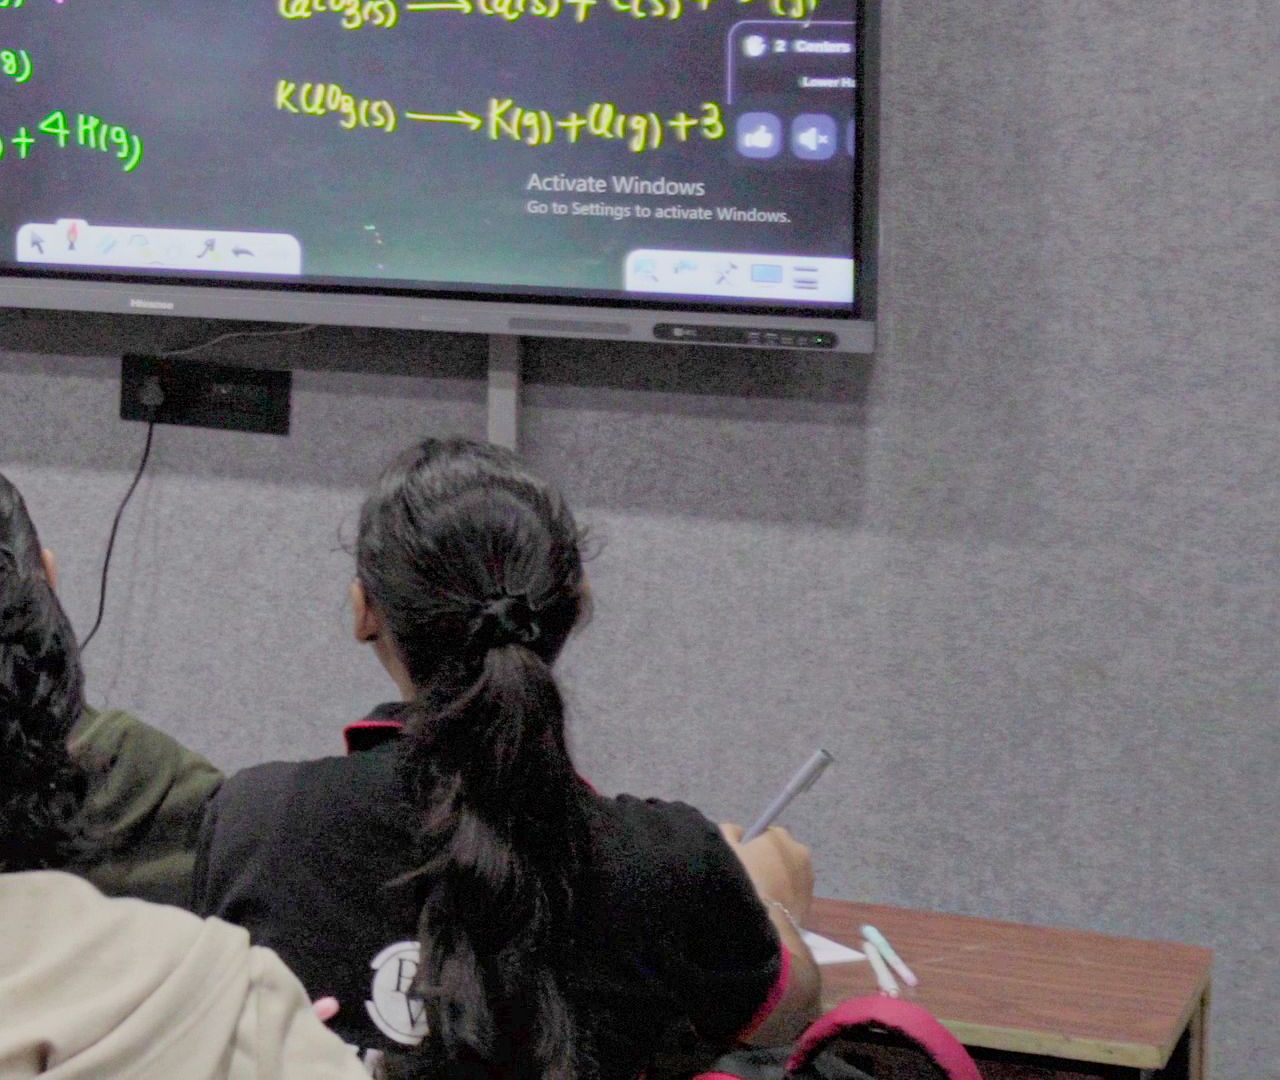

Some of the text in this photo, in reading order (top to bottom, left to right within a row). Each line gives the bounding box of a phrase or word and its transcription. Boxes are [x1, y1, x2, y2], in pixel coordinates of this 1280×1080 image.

[527, 173, 705, 197] Activate Windows
[527, 200, 792, 223] Go to Settings to activate Windows.
